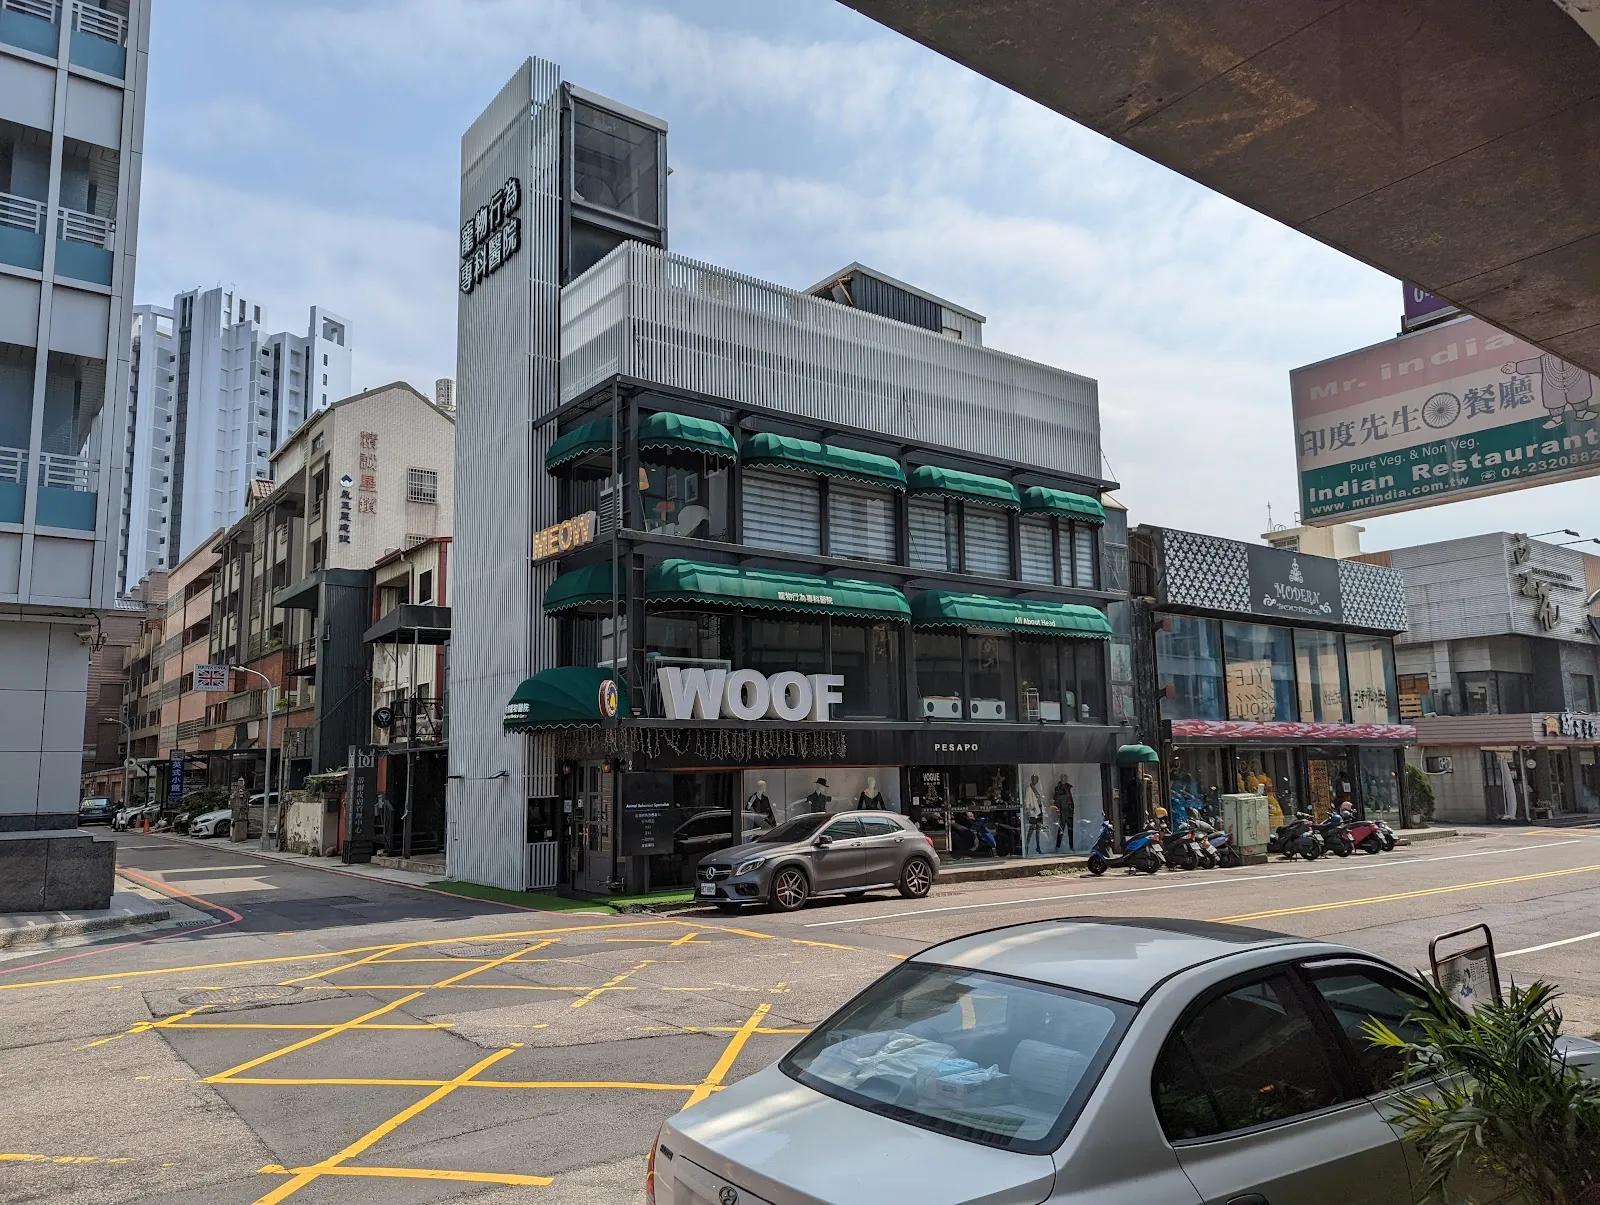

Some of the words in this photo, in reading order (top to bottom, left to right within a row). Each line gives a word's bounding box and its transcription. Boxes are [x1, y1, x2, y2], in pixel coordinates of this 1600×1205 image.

[460, 177, 520, 258] 寵物行為
[460, 217, 520, 293] 專科醫院
[1310, 378, 1367, 401] Mr.
[1380, 333, 1517, 381] india
[1300, 405, 1421, 457] 印度先生
[1462, 376, 1536, 420] 餐廳
[1310, 474, 1395, 503] Indian
[1411, 428, 1600, 482] Restaurant
[1350, 459, 1377, 473] Pure
[1379, 454, 1406, 467] Veg.
[1409, 449, 1419, 460] &
[1422, 444, 1448, 457] Non
[1450, 438, 1481, 451] Veg.
[532, 510, 597, 561] MEOW
[1273, 582, 1321, 606] MODERN
[1023, 617, 1041, 626] About
[657, 666, 844, 721] WOOF
[934, 743, 979, 752] PESAPO
[923, 772, 941, 781] VOGUE
